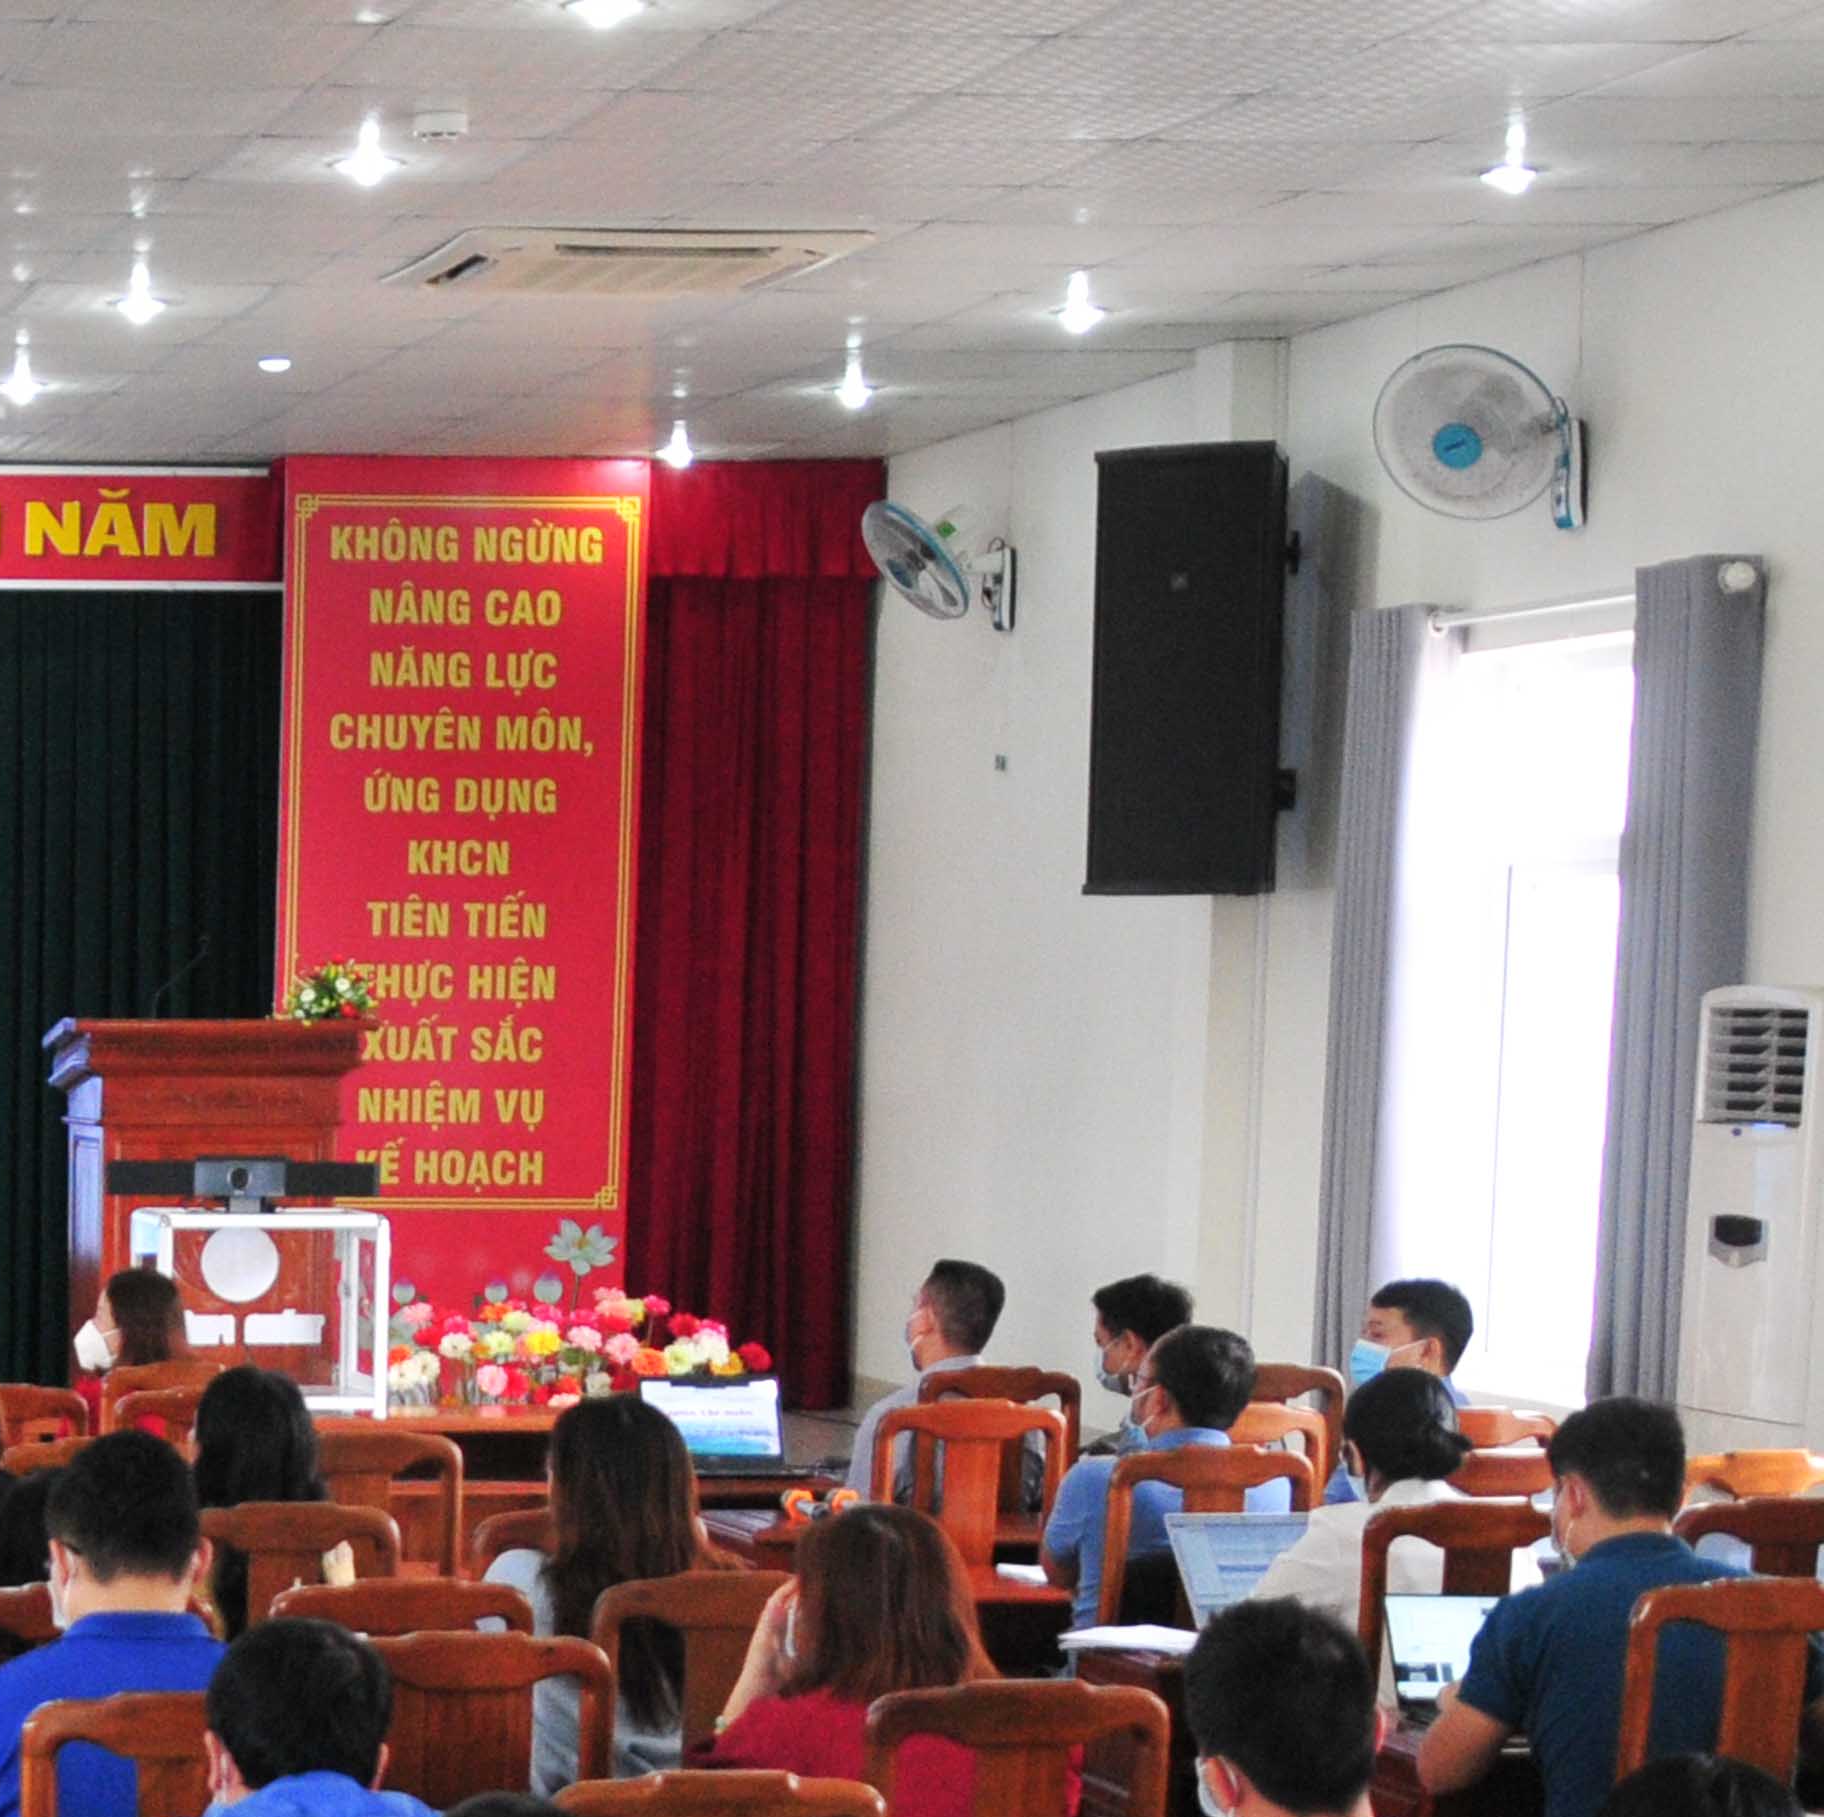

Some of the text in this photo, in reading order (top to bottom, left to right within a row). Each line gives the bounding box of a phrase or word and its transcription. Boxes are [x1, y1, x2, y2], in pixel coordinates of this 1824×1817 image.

[25, 487, 216, 557] NĂM
[330, 518, 604, 564] KHÔNG NGỪNG
[369, 580, 562, 626] NÂNG CAO
[369, 644, 558, 696] NĂNG LỰC
[330, 707, 594, 757] CHUYÊN MÔN,
[364, 768, 557, 821] ỨNG DỤNG
[408, 840, 510, 875] KHCN
[367, 890, 547, 938] TIÊN TIẾN
[469, 957, 557, 1009] HIỆN
[362, 1015, 544, 1061] XUẤT SẮC
[358, 1082, 545, 1133] NHIỆM VỤ
[414, 1149, 544, 1192] HOẠCH
